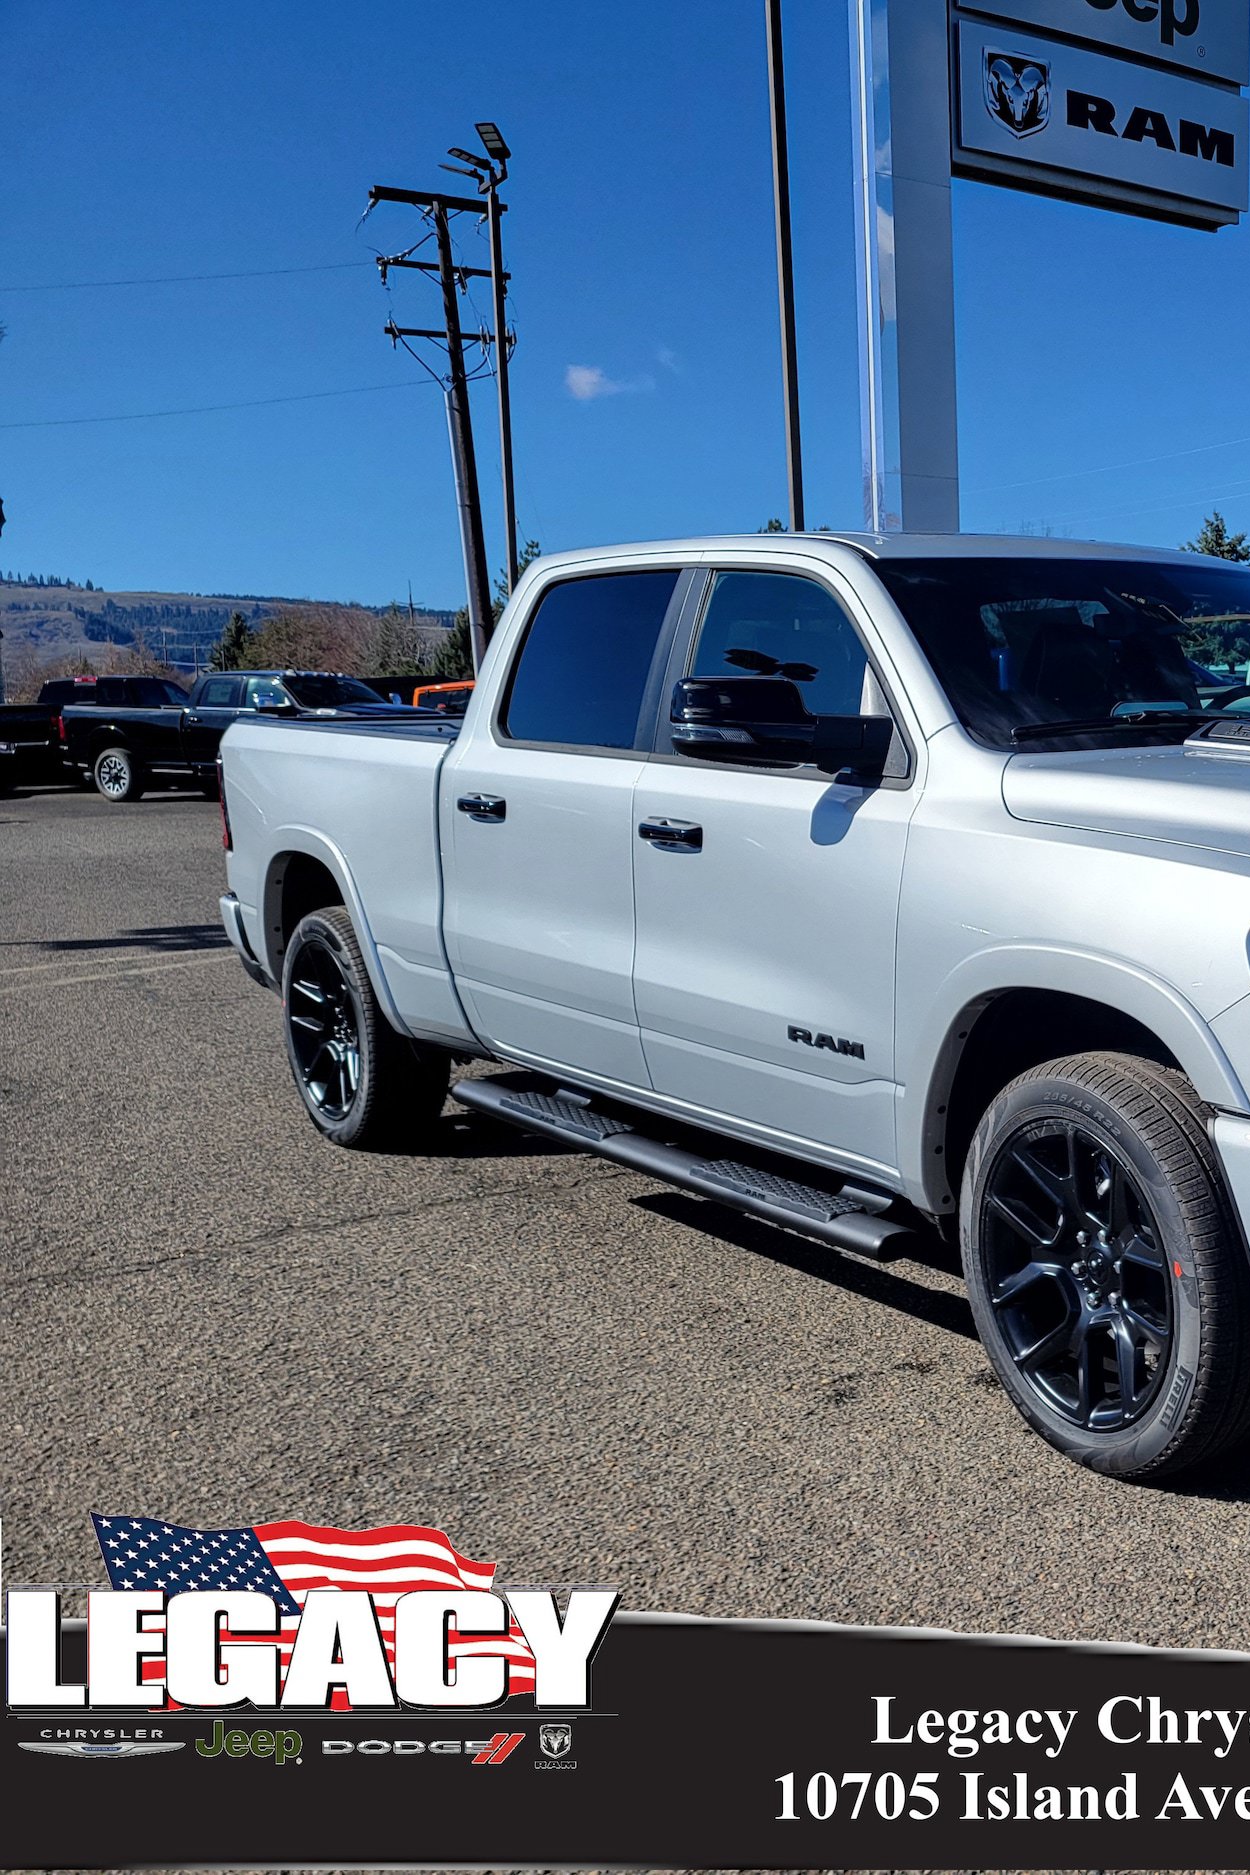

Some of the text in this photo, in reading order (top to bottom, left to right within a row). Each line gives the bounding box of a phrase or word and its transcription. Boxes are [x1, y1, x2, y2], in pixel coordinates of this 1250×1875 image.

[1084, 0, 1200, 47] ep
[1065, 89, 1235, 168] RAM
[787, 1024, 865, 1061] RAM
